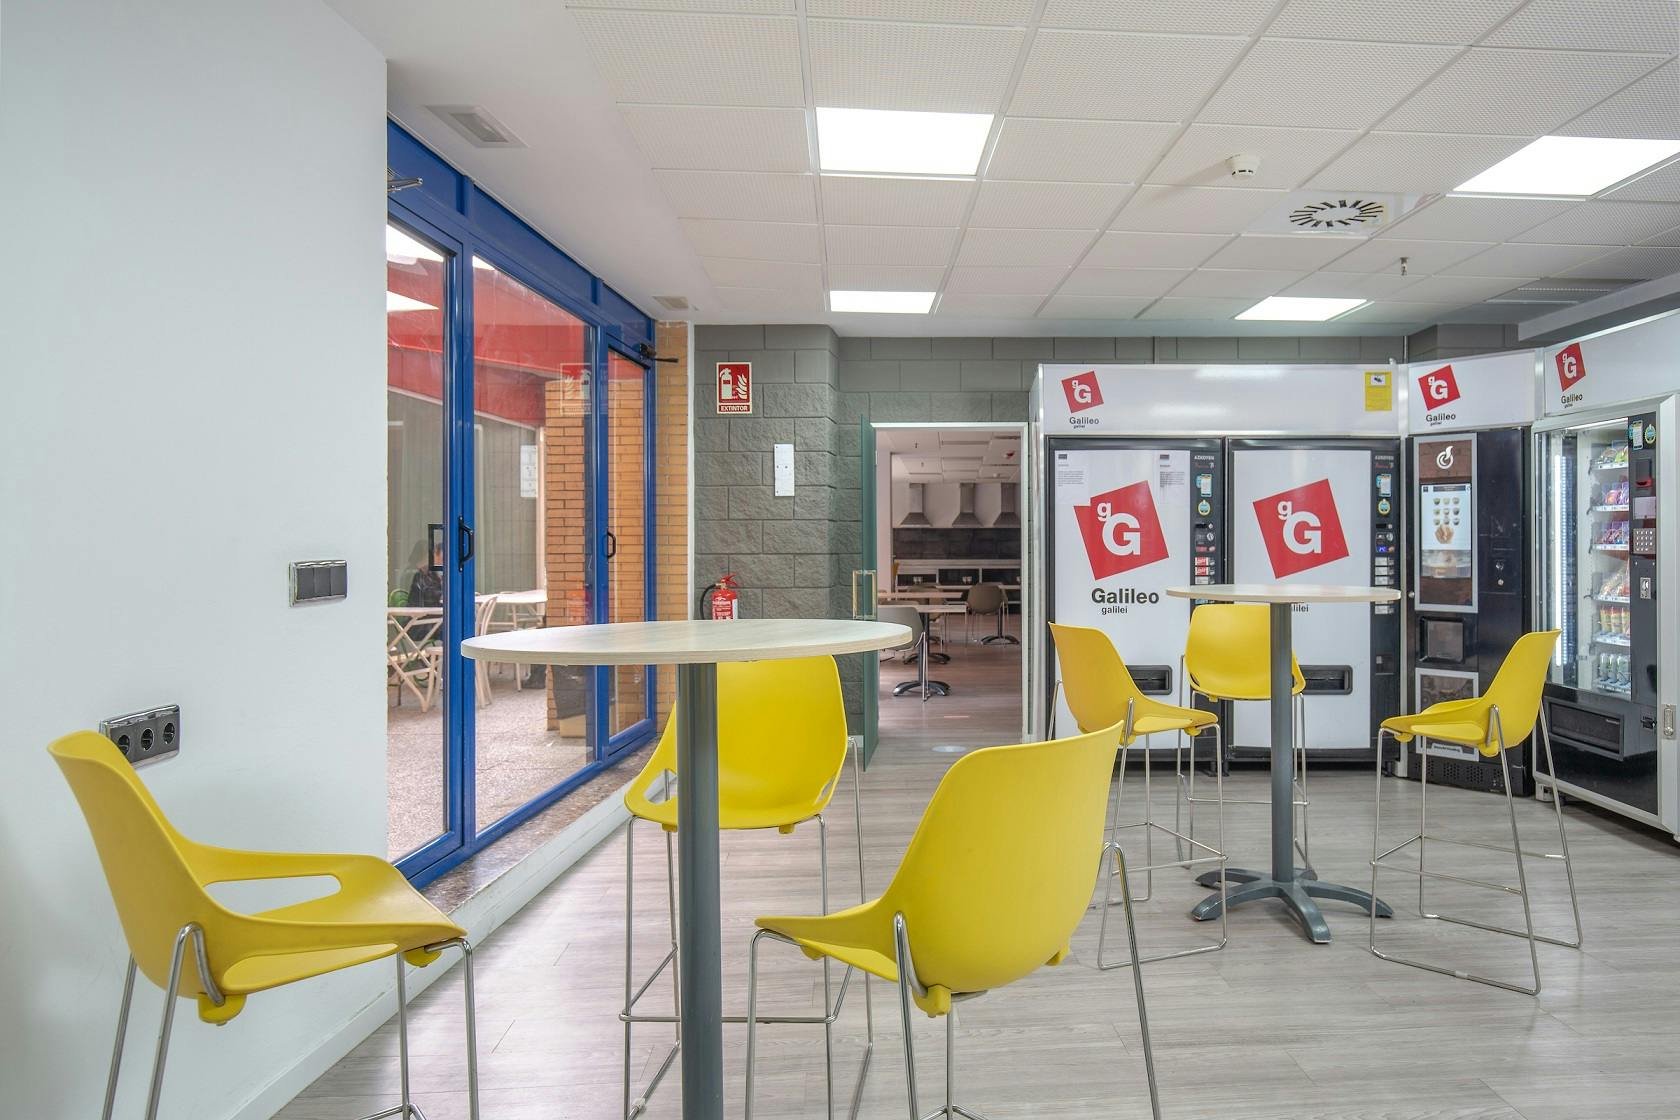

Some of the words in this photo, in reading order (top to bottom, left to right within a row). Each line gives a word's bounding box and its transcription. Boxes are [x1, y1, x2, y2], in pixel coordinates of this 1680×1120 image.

[1561, 394, 1583, 404] Galileo
[1069, 416, 1100, 425] Galileo
[1426, 413, 1456, 422] Galileo
[1091, 587, 1160, 604] Galileo
[1101, 605, 1128, 615] galilei
[1293, 603, 1309, 612] lilei
